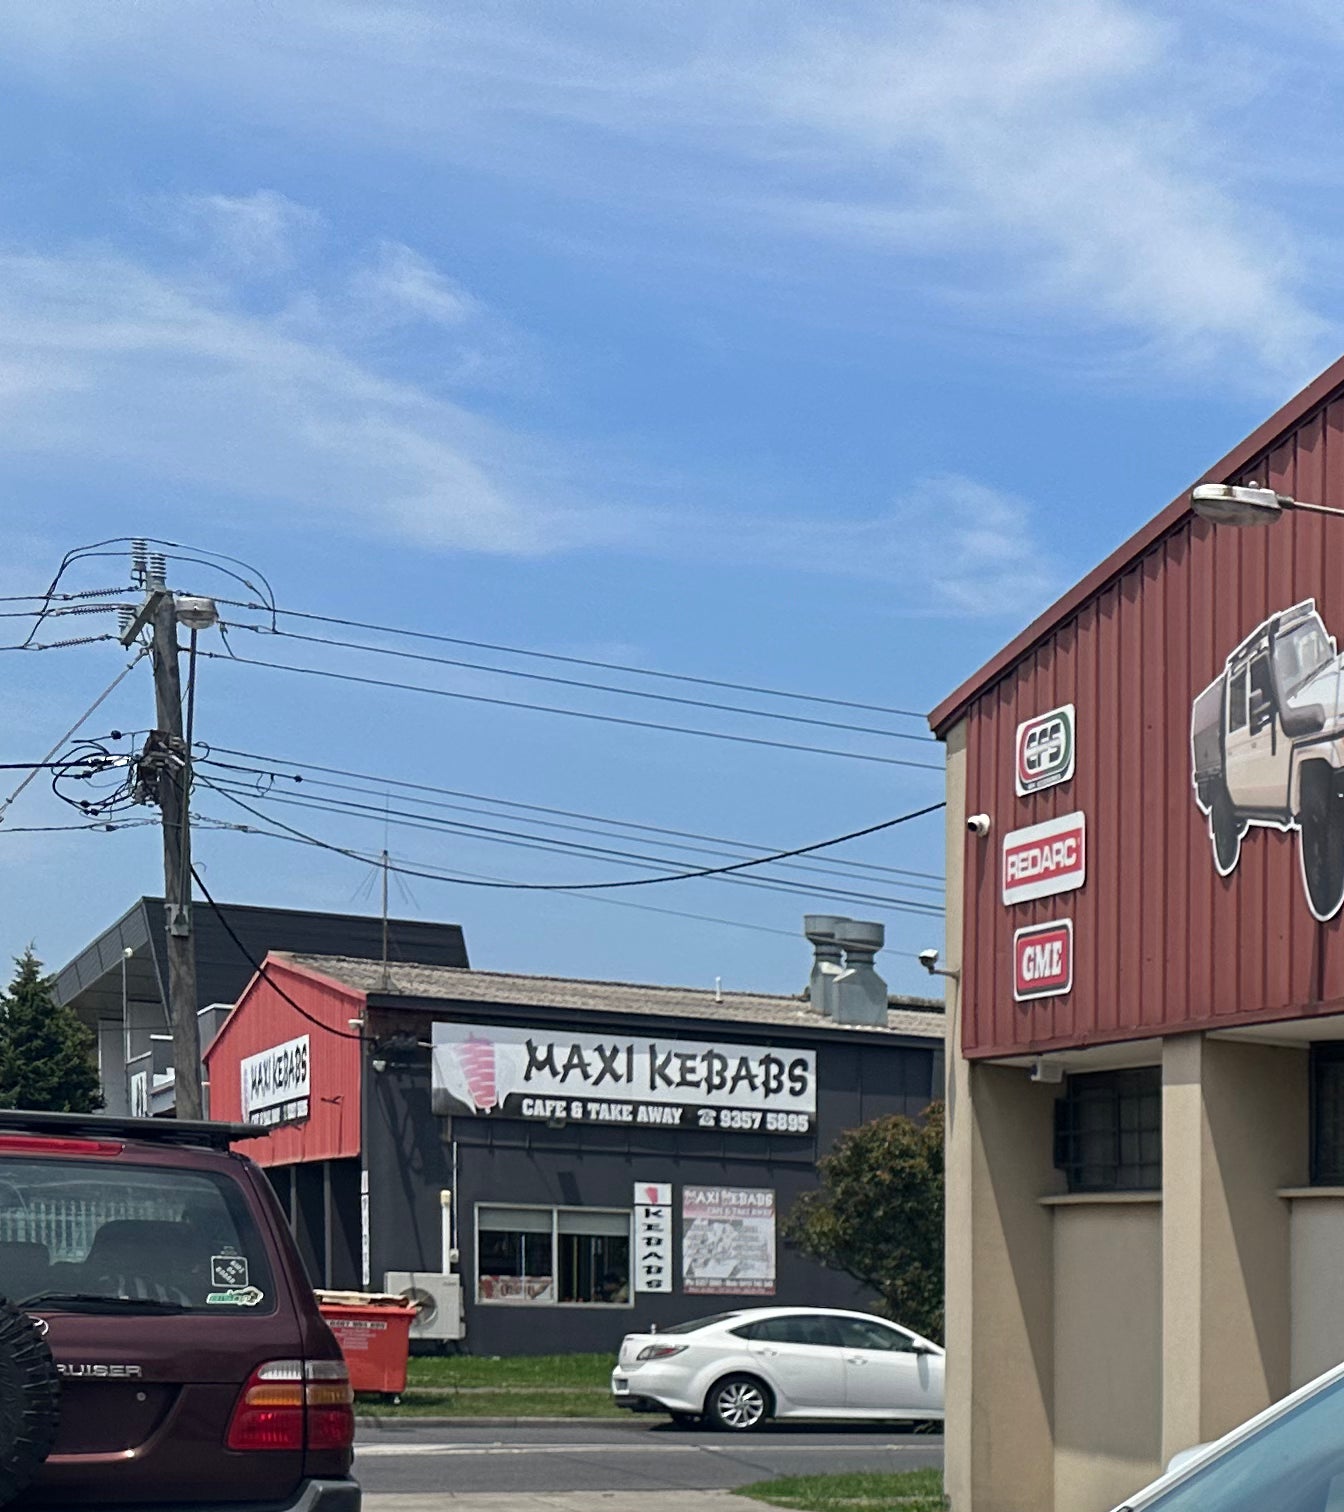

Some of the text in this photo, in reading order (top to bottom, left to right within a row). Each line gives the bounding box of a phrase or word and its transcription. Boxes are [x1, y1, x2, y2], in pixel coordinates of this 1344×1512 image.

[1007, 839, 1077, 883] REDARC
[1022, 940, 1062, 982] GME
[523, 1038, 809, 1098] MAXI KEBABS
[521, 1098, 567, 1118] CAFE
[570, 1101, 583, 1118] &
[587, 1102, 634, 1122] TAKE
[636, 1105, 683, 1125] AWAY
[719, 1109, 762, 1130] 9357
[642, 1207, 664, 1289] KEBABS
[56, 1364, 142, 1378] RUISER
